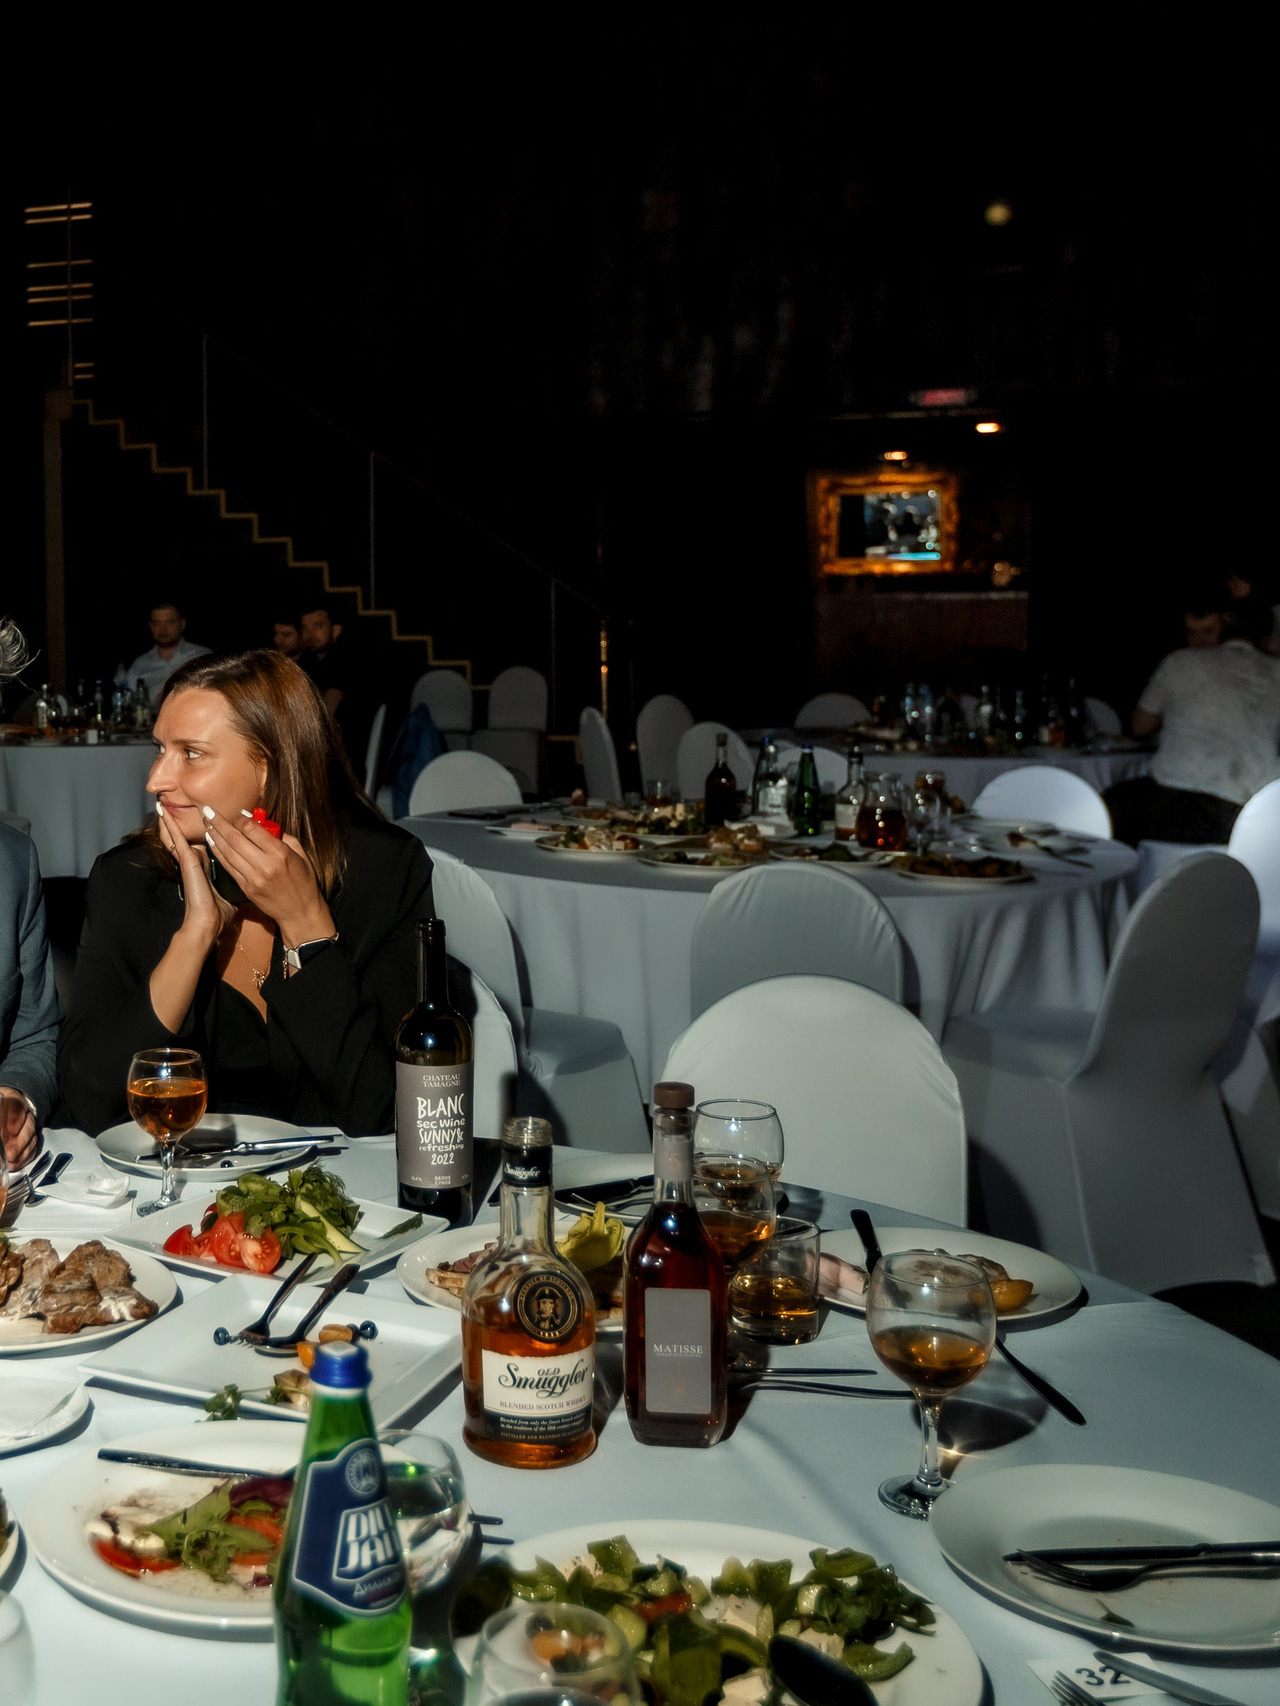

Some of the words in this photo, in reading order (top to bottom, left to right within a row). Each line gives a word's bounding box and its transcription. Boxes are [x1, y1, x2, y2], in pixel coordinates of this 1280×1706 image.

[423, 1073, 461, 1081] CHATEAU
[423, 1080, 461, 1088] TAMAGNE
[416, 1093, 464, 1119] BLANC
[416, 1119, 438, 1129] sec
[431, 1152, 455, 1165] 2022
[653, 1343, 704, 1354] MATISSE
[537, 1367, 561, 1376] OLD
[498, 1358, 589, 1398] Smuggler
[500, 1400, 535, 1411] BLENDED
[536, 1402, 564, 1411] SCOTCH
[1074, 1664, 1132, 1686] 32
